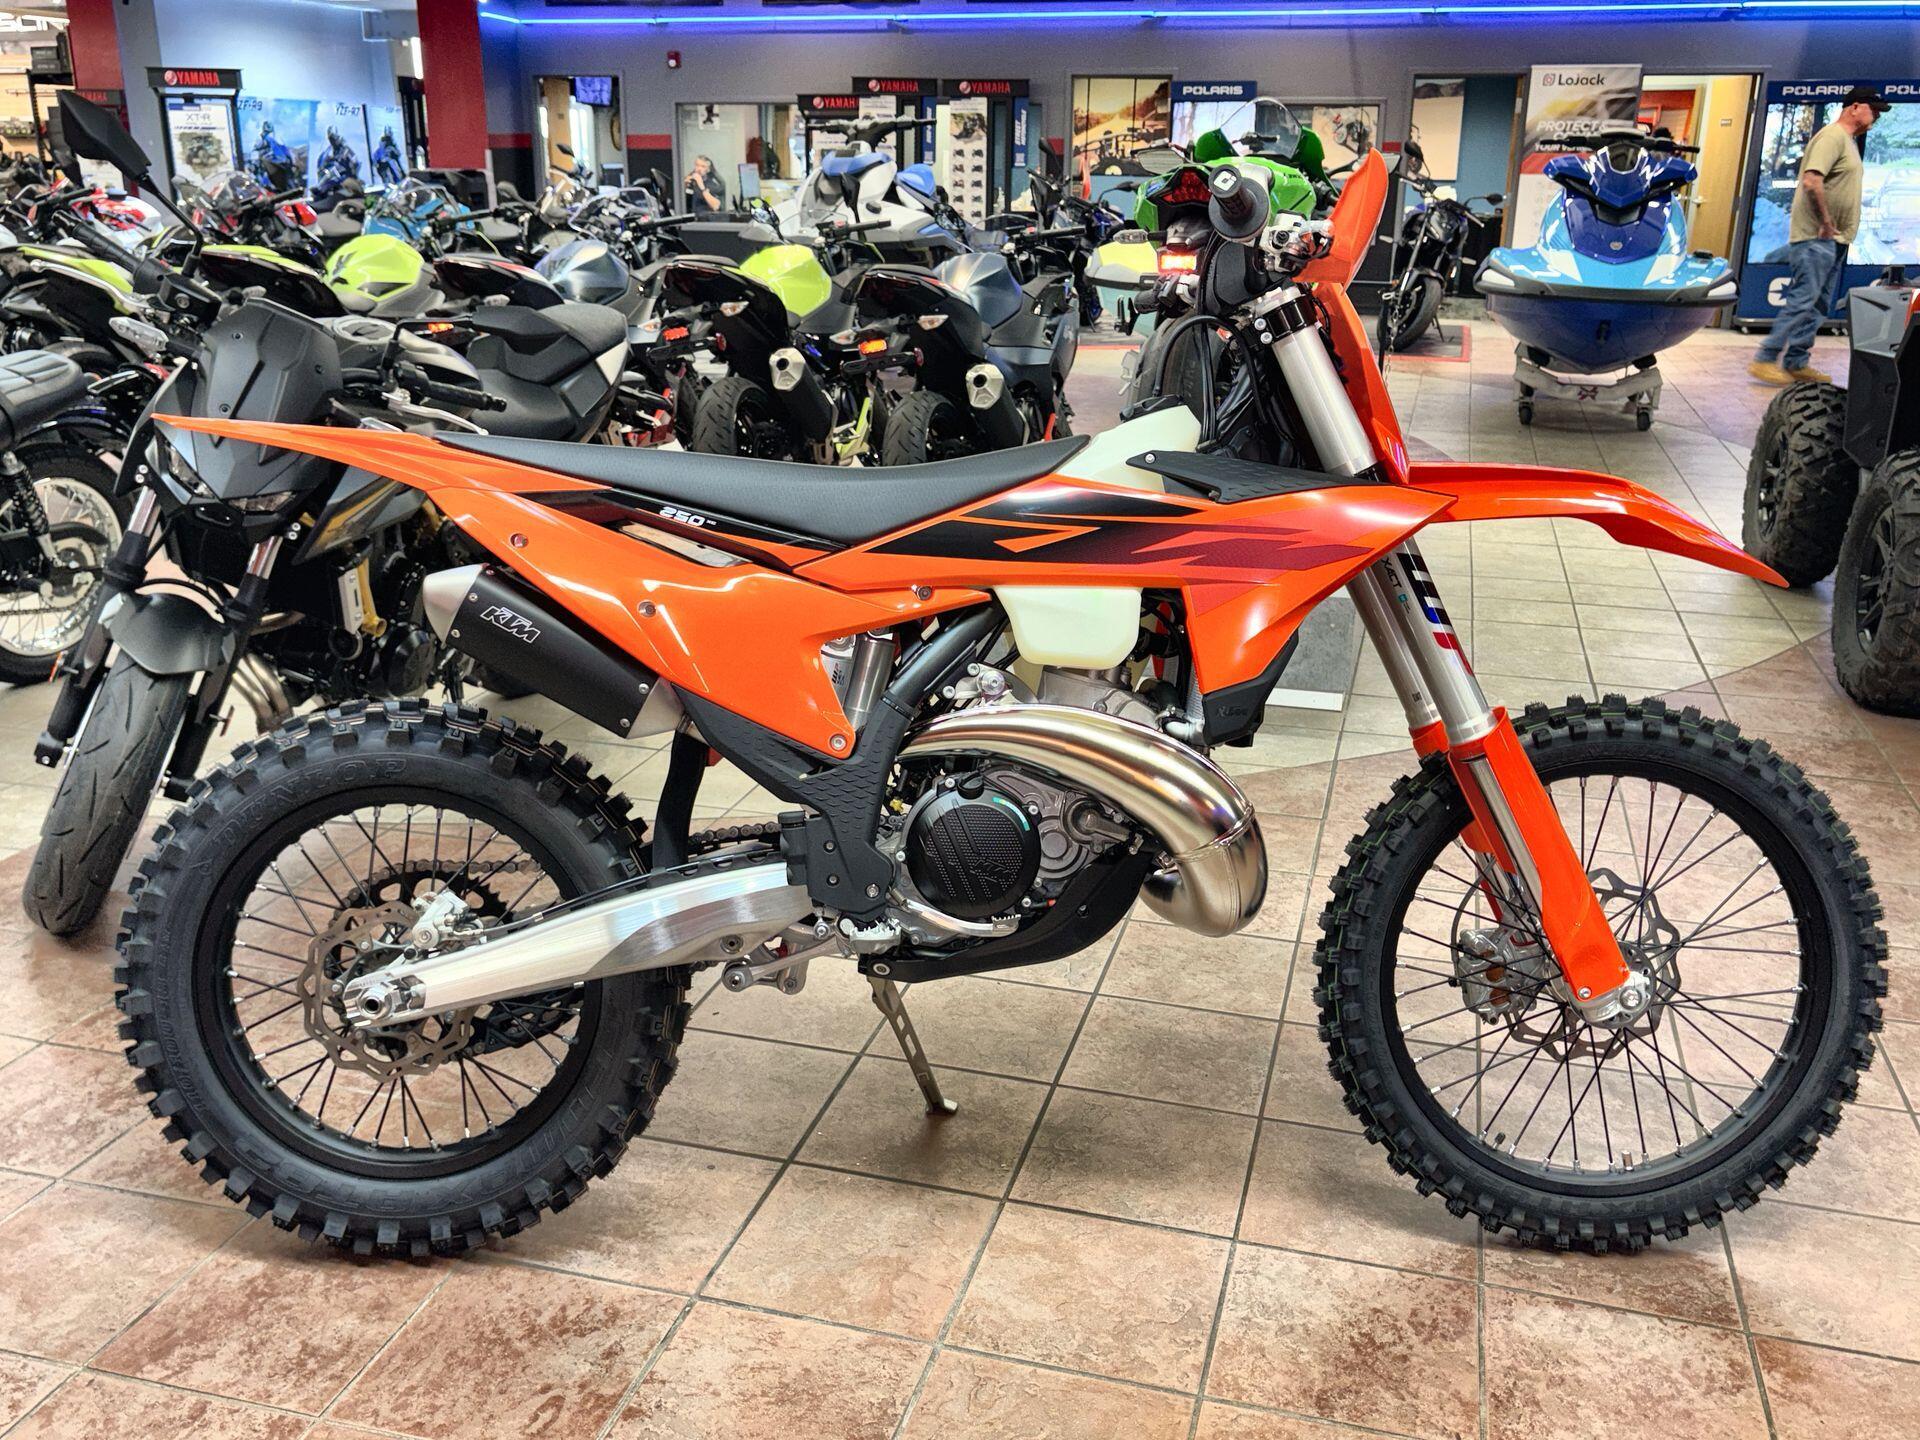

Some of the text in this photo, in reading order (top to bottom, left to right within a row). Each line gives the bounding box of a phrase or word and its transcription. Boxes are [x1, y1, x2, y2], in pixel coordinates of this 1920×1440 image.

[177, 71, 220, 85] YAMAHA
[881, 80, 919, 92] YAMAHA
[971, 81, 1011, 93] YAMAHA
[1182, 85, 1244, 96] POLARIS
[1782, 85, 1855, 96] POLARIS
[1884, 84, 1920, 95] POL
[1536, 119, 1599, 132] PROTECT
[659, 506, 706, 527] 250
[1381, 556, 1403, 588] XACT
[480, 605, 541, 644] KTM
[212, 757, 407, 842] DUNLOP
